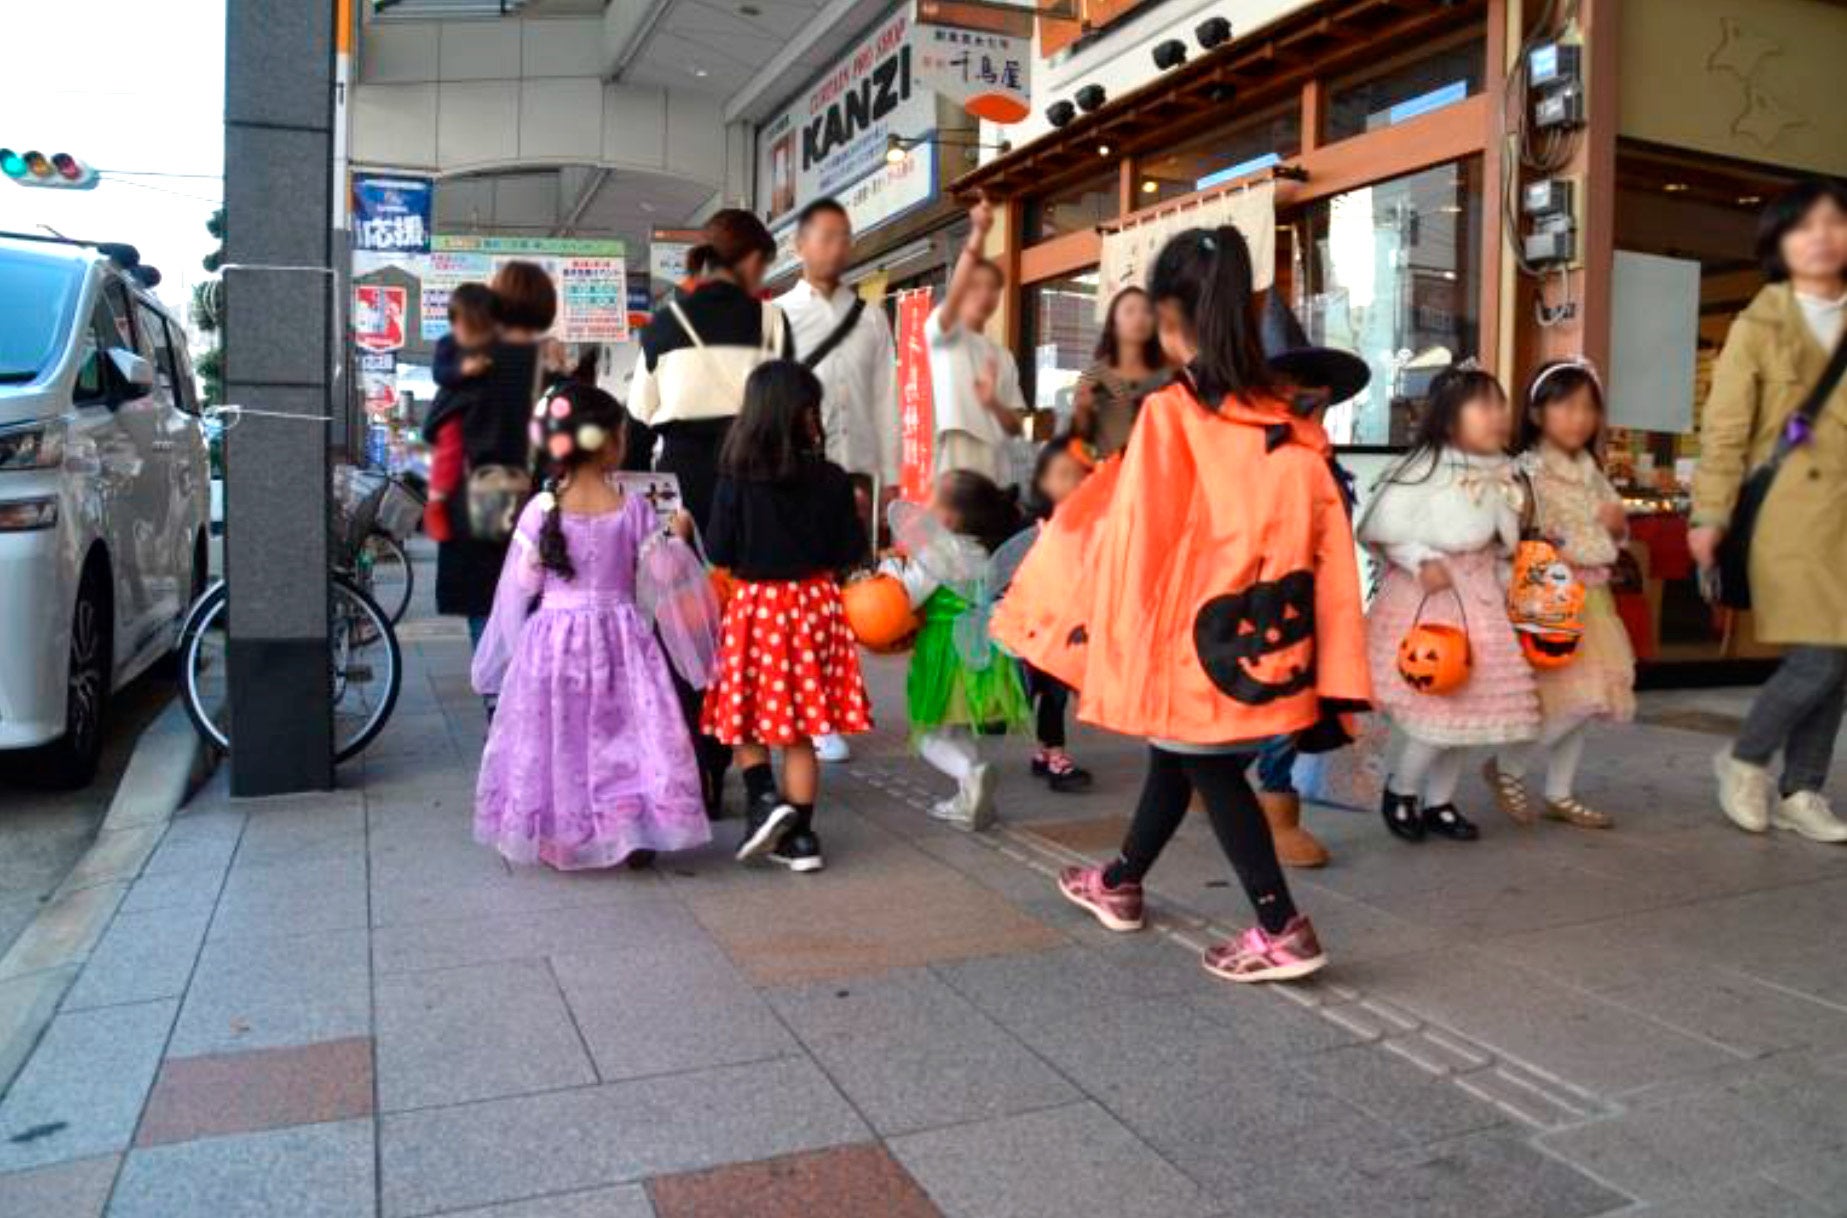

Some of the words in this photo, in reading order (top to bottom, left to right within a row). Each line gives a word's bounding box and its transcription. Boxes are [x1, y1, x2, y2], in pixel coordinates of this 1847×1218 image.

[802, 45, 912, 171] KANZI
[950, 51, 1022, 90] 千鳥屋
